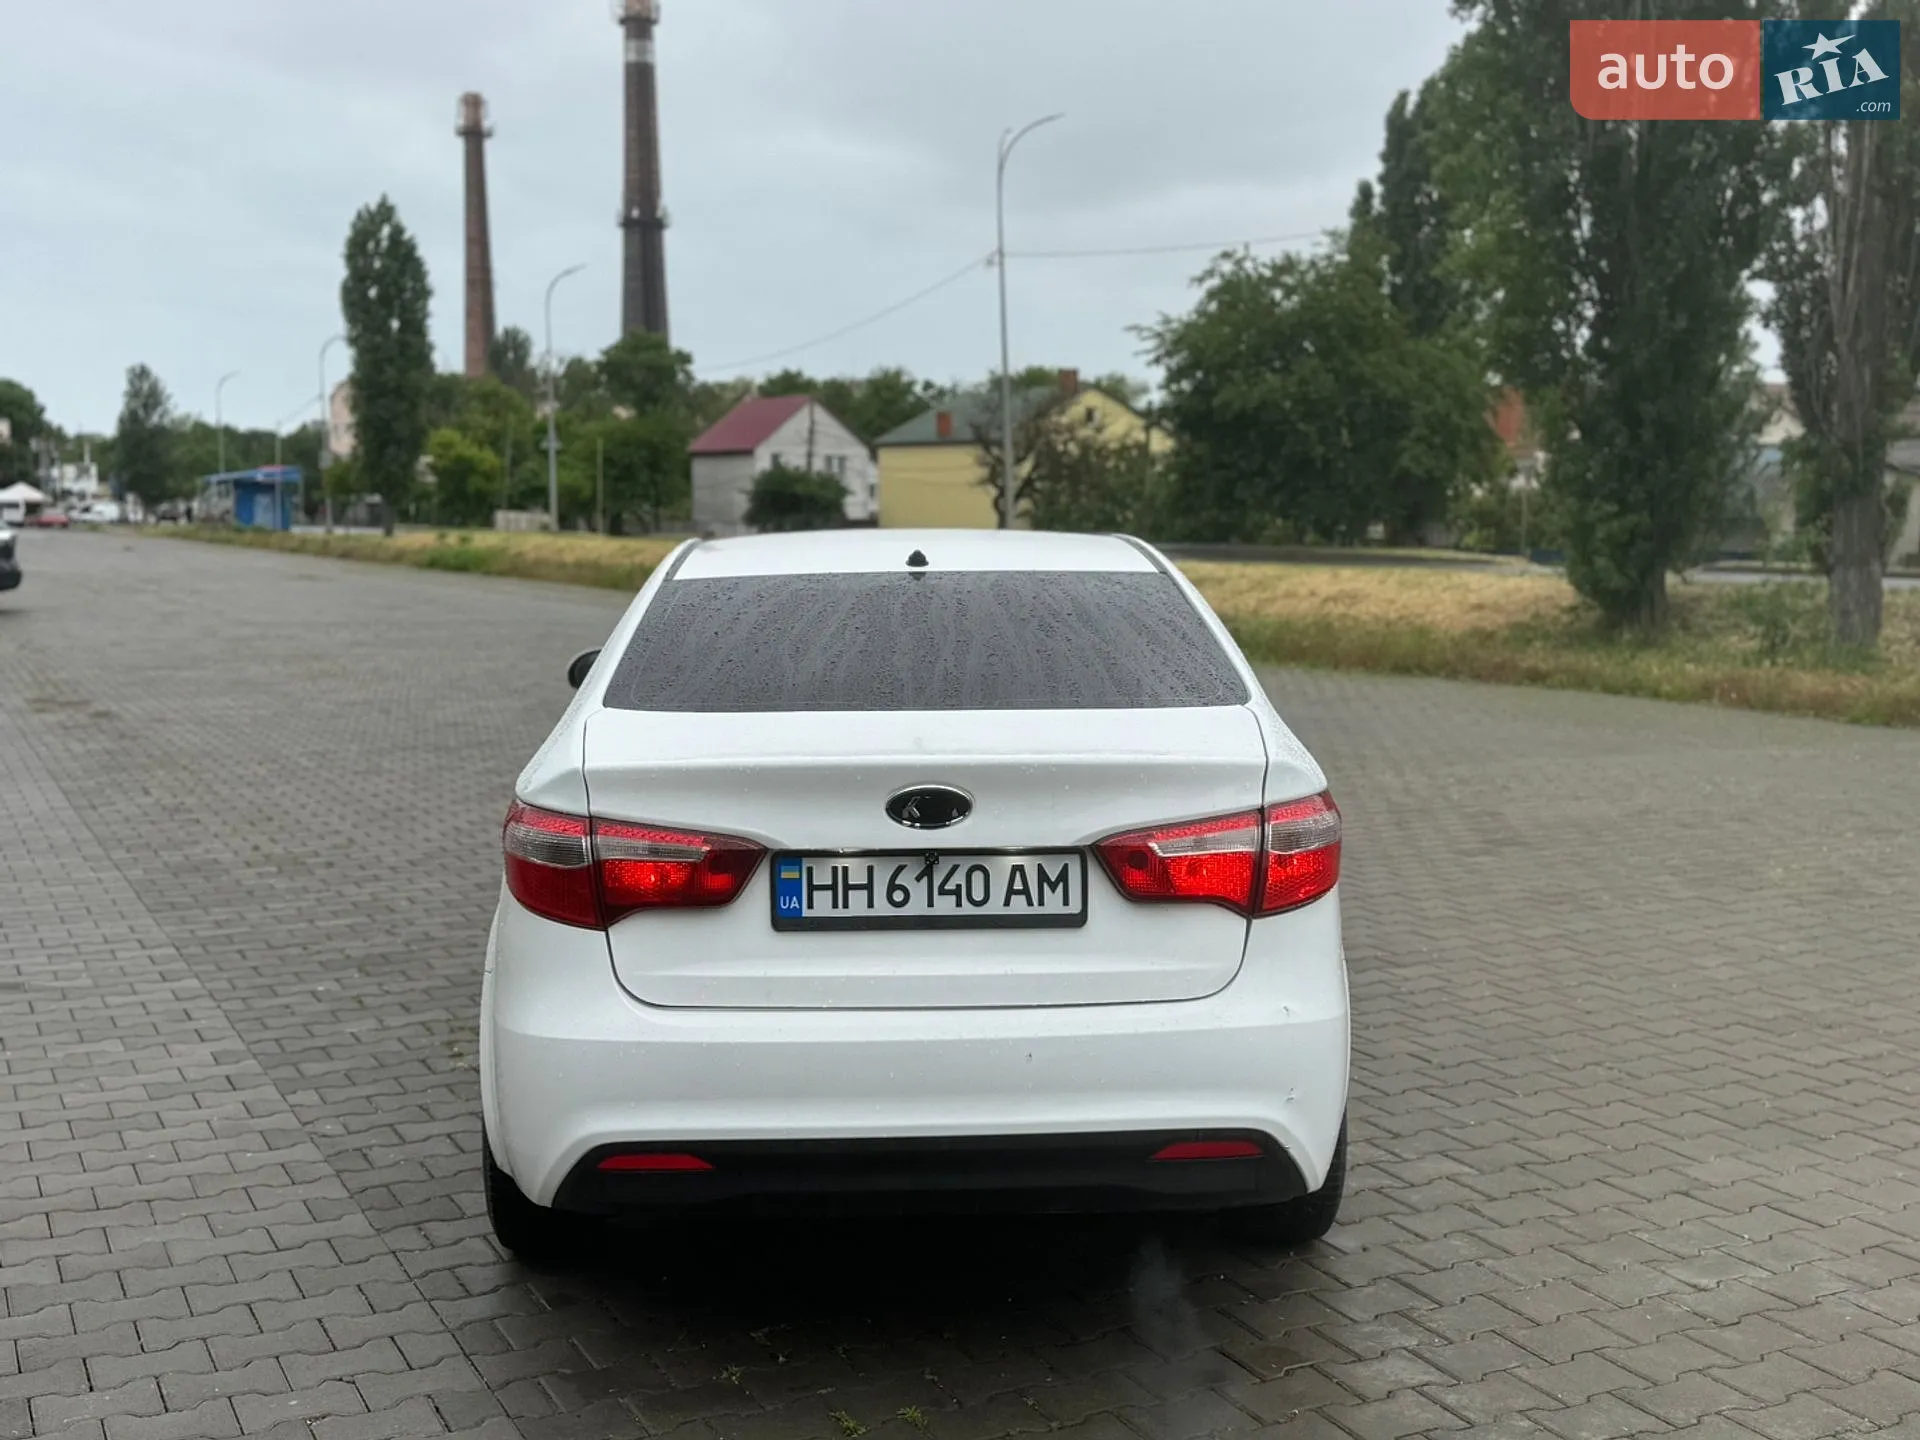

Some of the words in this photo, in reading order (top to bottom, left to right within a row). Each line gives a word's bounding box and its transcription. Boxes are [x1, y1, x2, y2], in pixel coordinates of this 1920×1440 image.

[806, 865, 875, 909] HH
[886, 863, 990, 908] 6140
[1003, 863, 1070, 907] AM
[780, 896, 800, 909] UA
